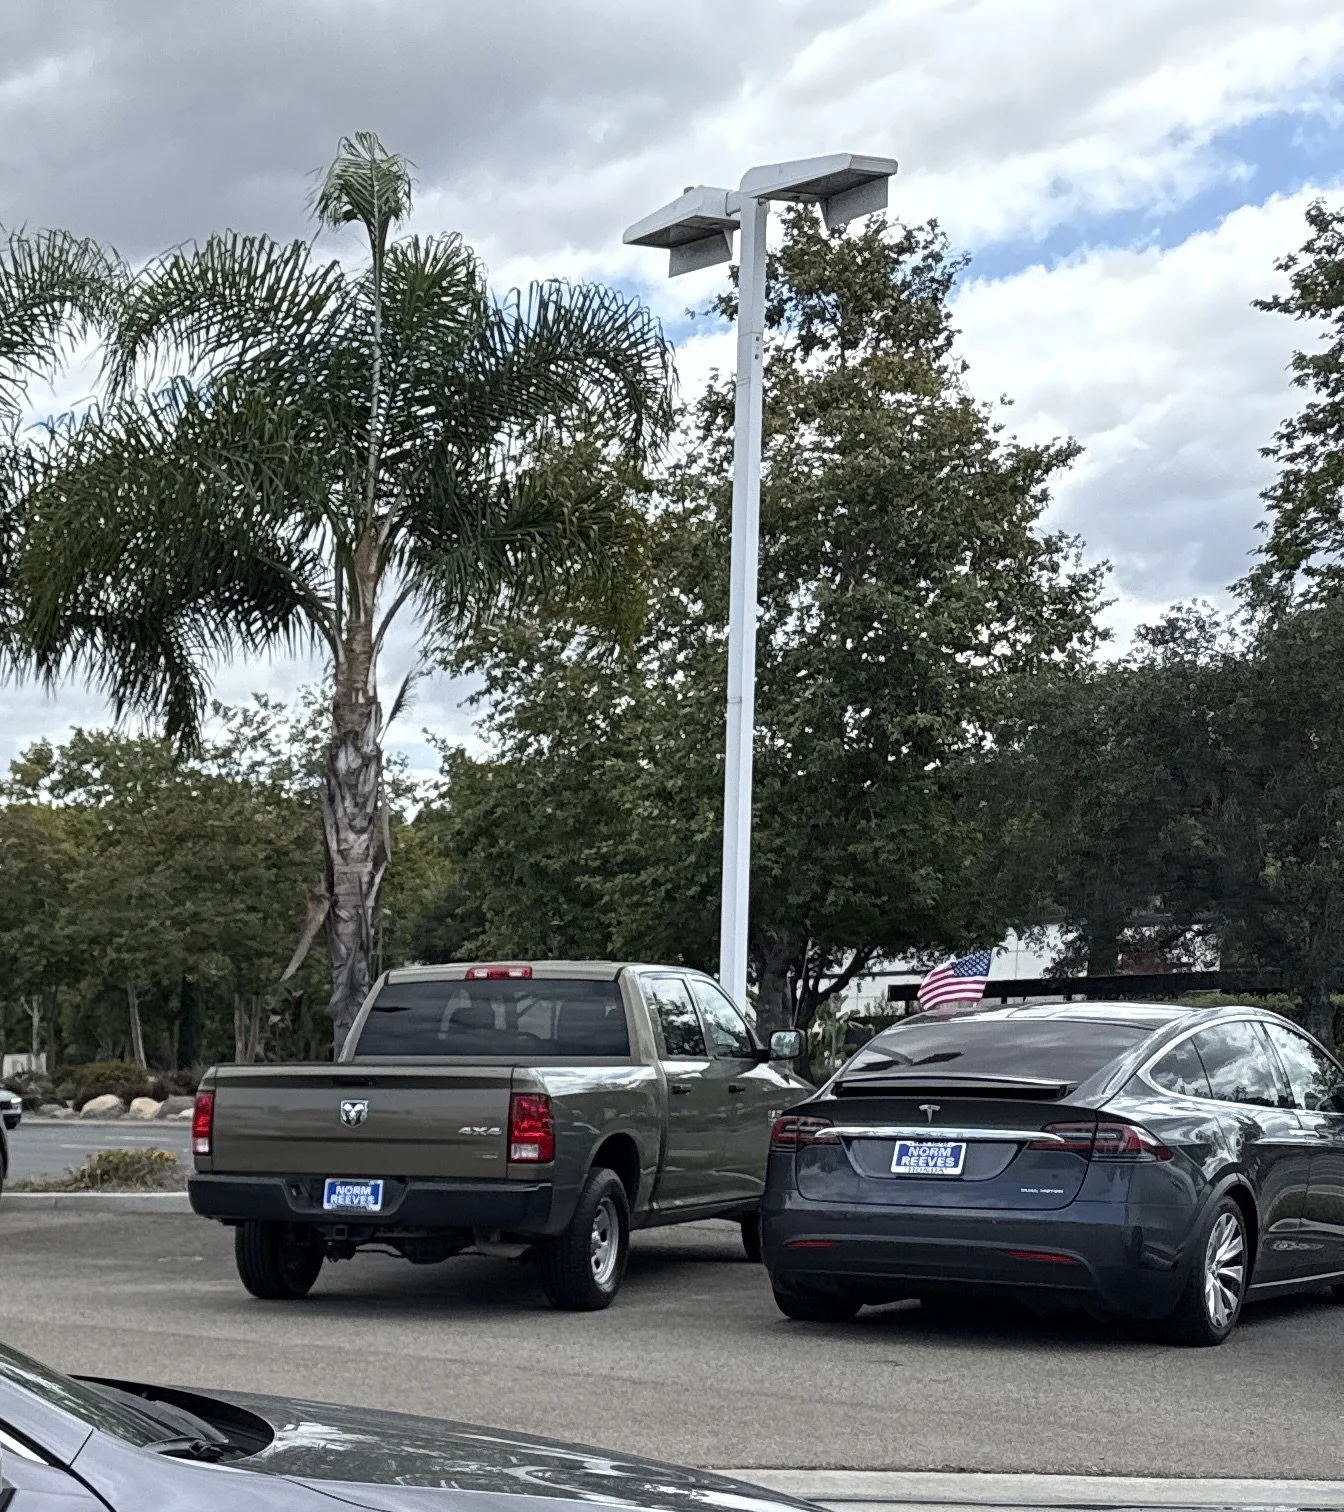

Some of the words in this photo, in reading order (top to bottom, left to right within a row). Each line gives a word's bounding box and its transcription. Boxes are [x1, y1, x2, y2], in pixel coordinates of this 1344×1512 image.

[908, 1146, 952, 1157] NORM
[901, 1156, 955, 1167] REEVES
[336, 1185, 372, 1195] NORM
[330, 1194, 375, 1205] REEVES
